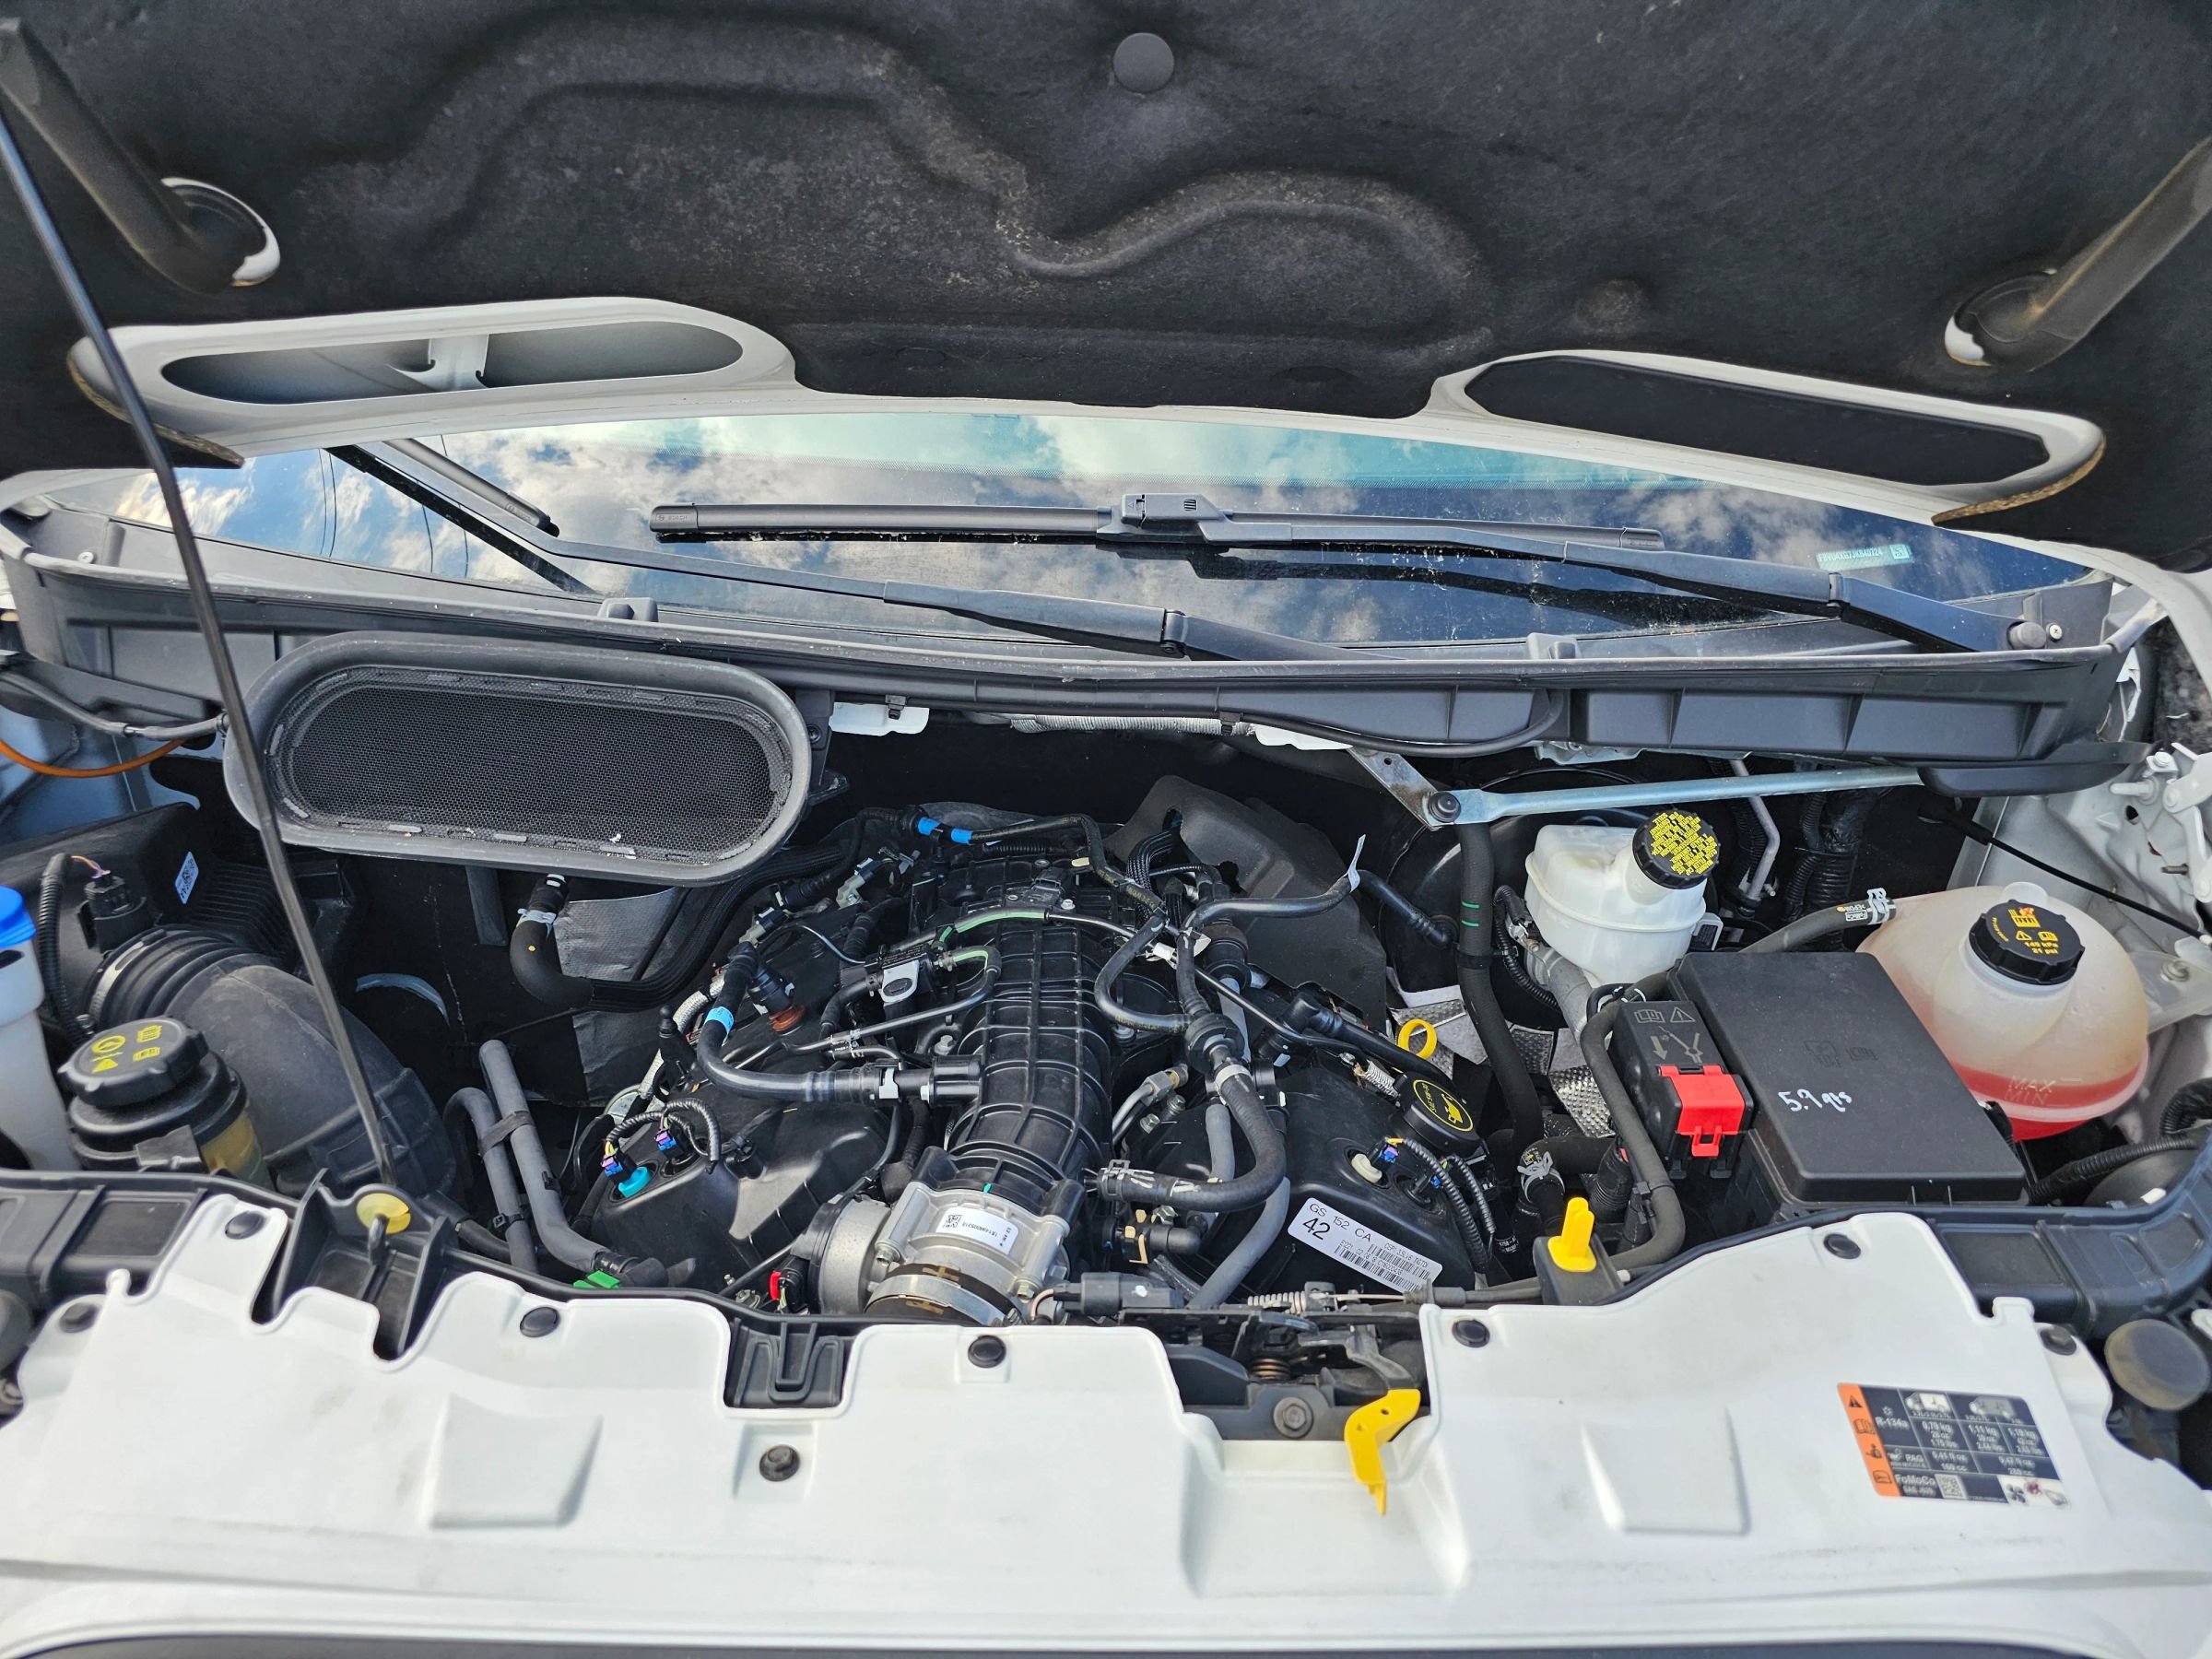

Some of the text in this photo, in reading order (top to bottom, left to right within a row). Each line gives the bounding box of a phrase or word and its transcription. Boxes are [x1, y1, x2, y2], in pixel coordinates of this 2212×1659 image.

[2008, 1075, 2056, 1093] MAX
[1309, 1203, 1371, 1242] GS 152 CA
[1302, 1218, 1331, 1241] 42
[1876, 1417, 1910, 1430] R-134a
[1940, 1422, 1953, 1434] kg
[1985, 1426, 2000, 1437] kg
[2024, 1430, 2039, 1440] kg
[1905, 1454, 1924, 1463] PAG
[1895, 1475, 1936, 1486] FoMoCo
